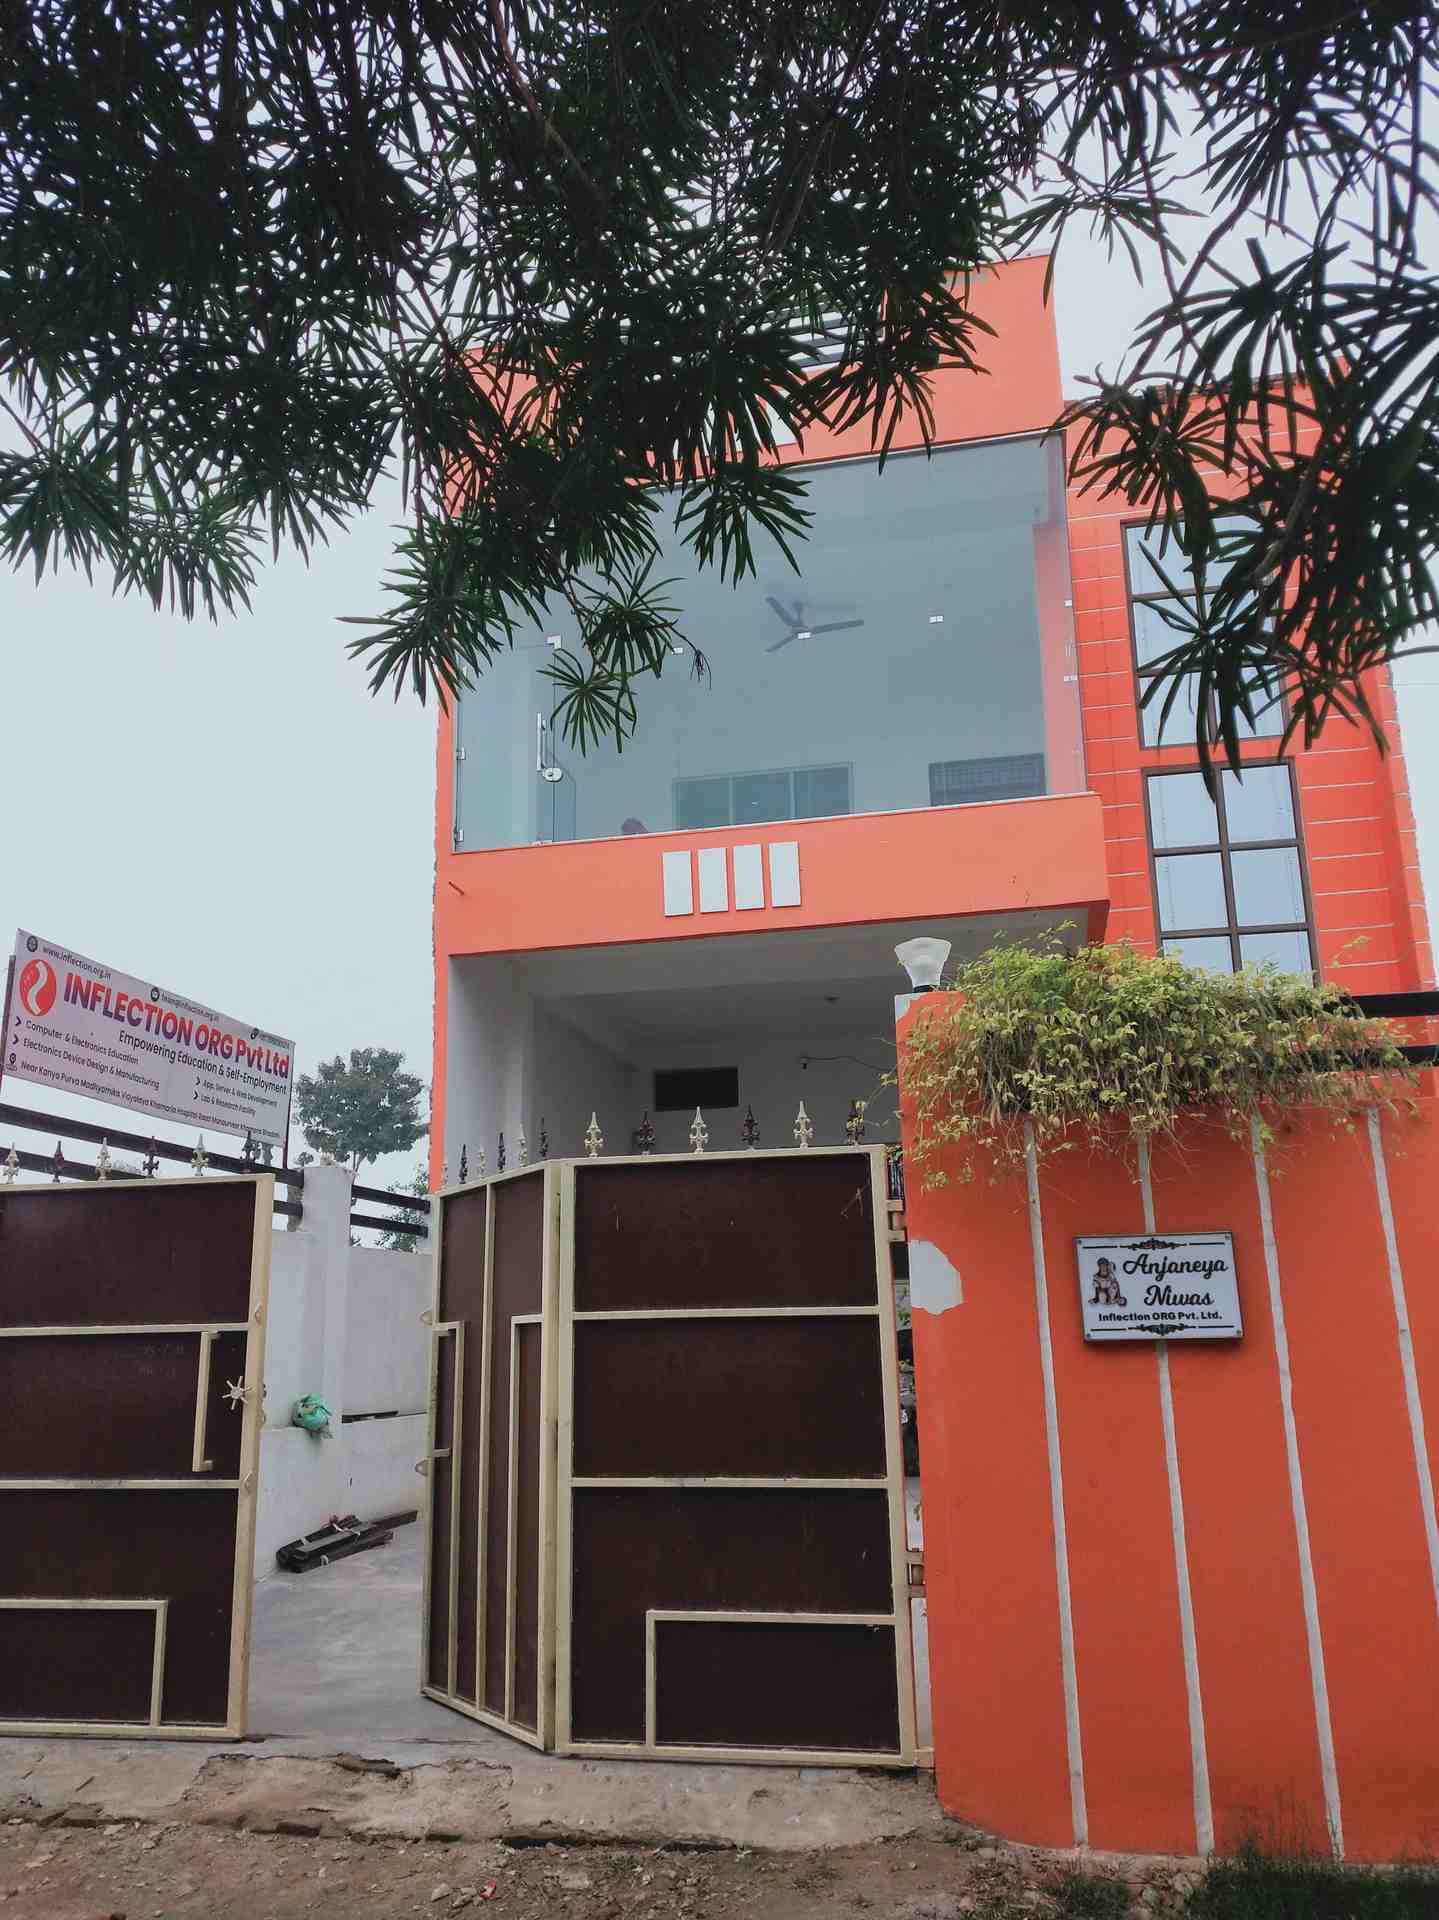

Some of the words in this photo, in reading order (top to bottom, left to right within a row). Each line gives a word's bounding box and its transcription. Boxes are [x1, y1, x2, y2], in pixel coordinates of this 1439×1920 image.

[25, 1020, 62, 1039] Computer
[71, 1034, 107, 1054] Electronics
[107, 1048, 138, 1064] Education
[64, 973, 193, 1046] INFLECTION
[195, 1024, 233, 1059] ORG
[235, 1039, 264, 1071] Pvt
[265, 1049, 289, 1079] Ltd
[20, 1059, 38, 1072] Near
[38, 1066, 60, 1081] Kanya
[23, 1038, 61, 1057] Electronics
[62, 1050, 86, 1065] Device
[86, 1058, 108, 1075] Design
[115, 1068, 159, 1090] Manufacturing
[119, 1030, 176, 1064] Empowering
[177, 1051, 217, 1074] Education
[218, 1064, 224, 1076] &
[225, 1067, 286, 1095] Self-Employment
[1122, 1254, 1228, 1281] Anjaneya
[1144, 1285, 1215, 1306] Niwas
[1099, 1313, 1150, 1321] Inflection
